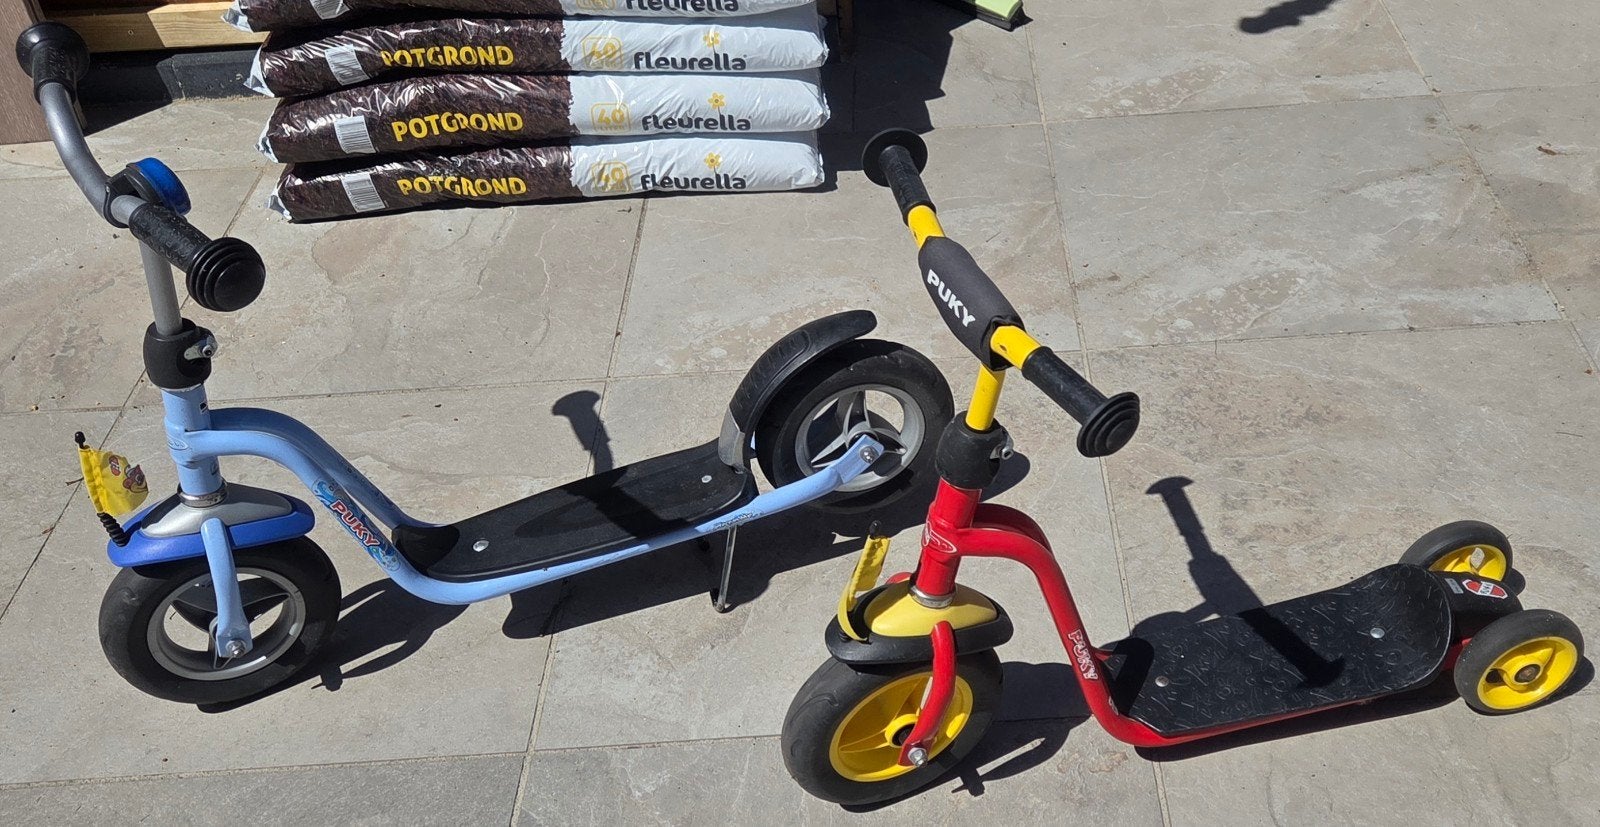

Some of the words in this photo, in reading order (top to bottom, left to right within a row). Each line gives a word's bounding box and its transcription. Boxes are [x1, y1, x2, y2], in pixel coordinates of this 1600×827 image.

[381, 46, 514, 67] POTGROND
[633, 52, 747, 71] fleurella
[598, 108, 625, 124] 40
[641, 114, 751, 131] fleurella
[391, 112, 523, 142] POTGROND
[397, 177, 527, 198] POTGROND
[640, 173, 747, 190] fleurella
[927, 269, 976, 327] PUKY
[330, 499, 380, 546] PUKY
[1068, 629, 1098, 680] PUKY
